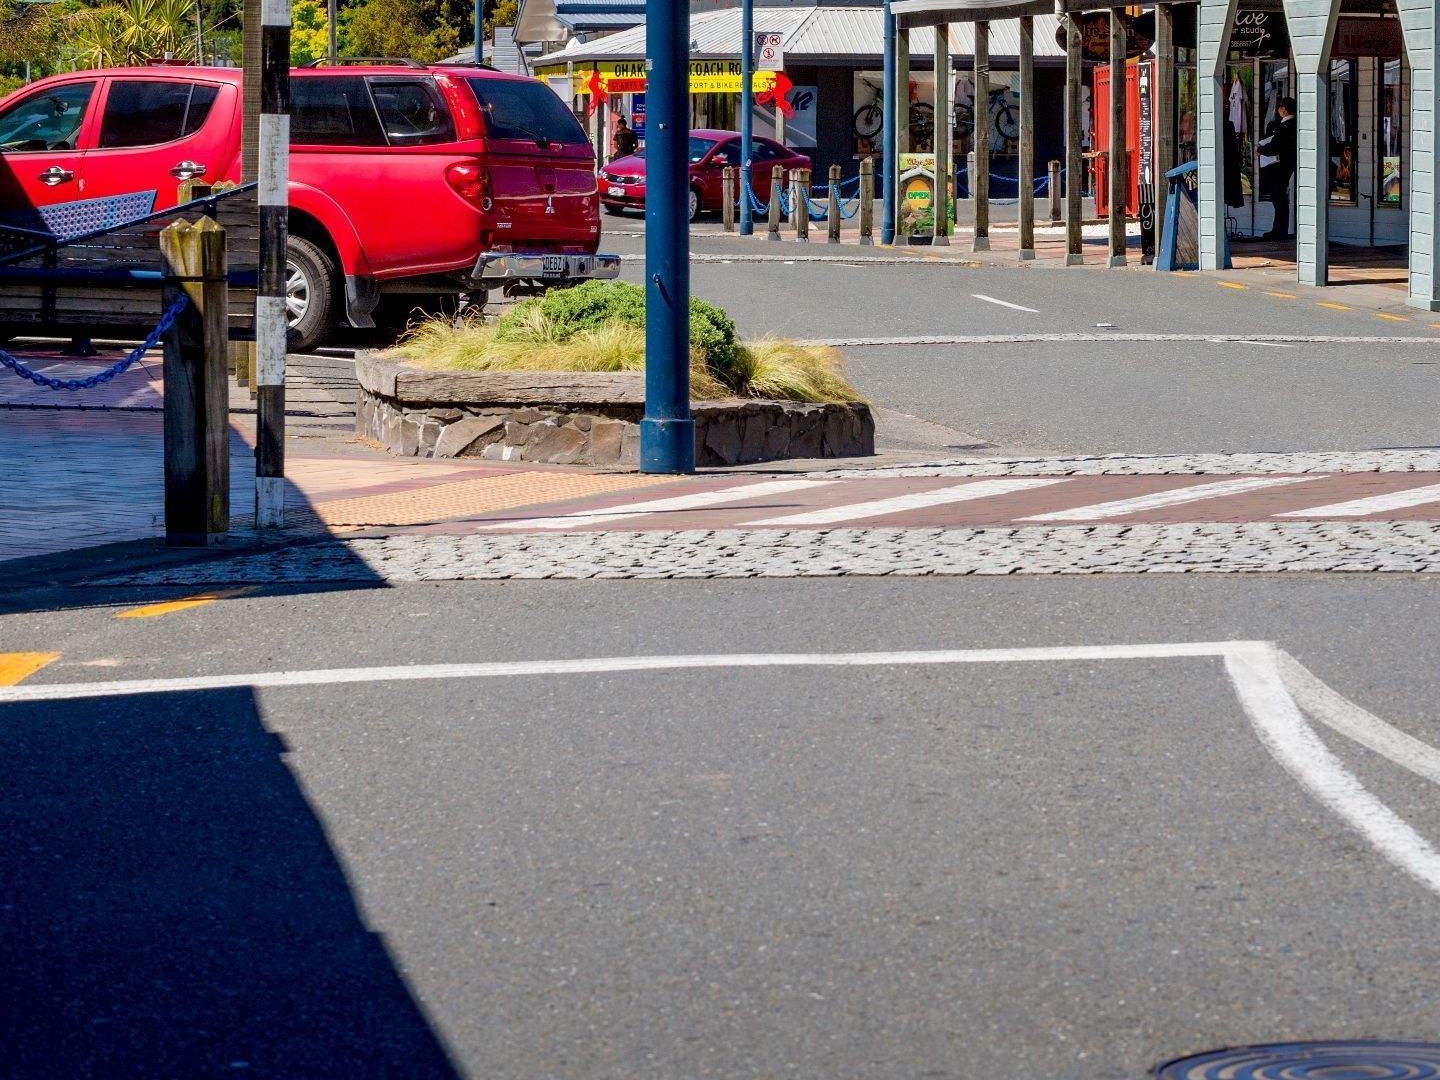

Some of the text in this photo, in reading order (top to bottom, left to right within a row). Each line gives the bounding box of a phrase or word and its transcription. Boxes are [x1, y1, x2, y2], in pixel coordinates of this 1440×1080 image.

[614, 63, 646, 77] OHAK
[611, 81, 637, 91] STARTS
[791, 91, 814, 111] K2
[907, 191, 930, 200] OPEN
